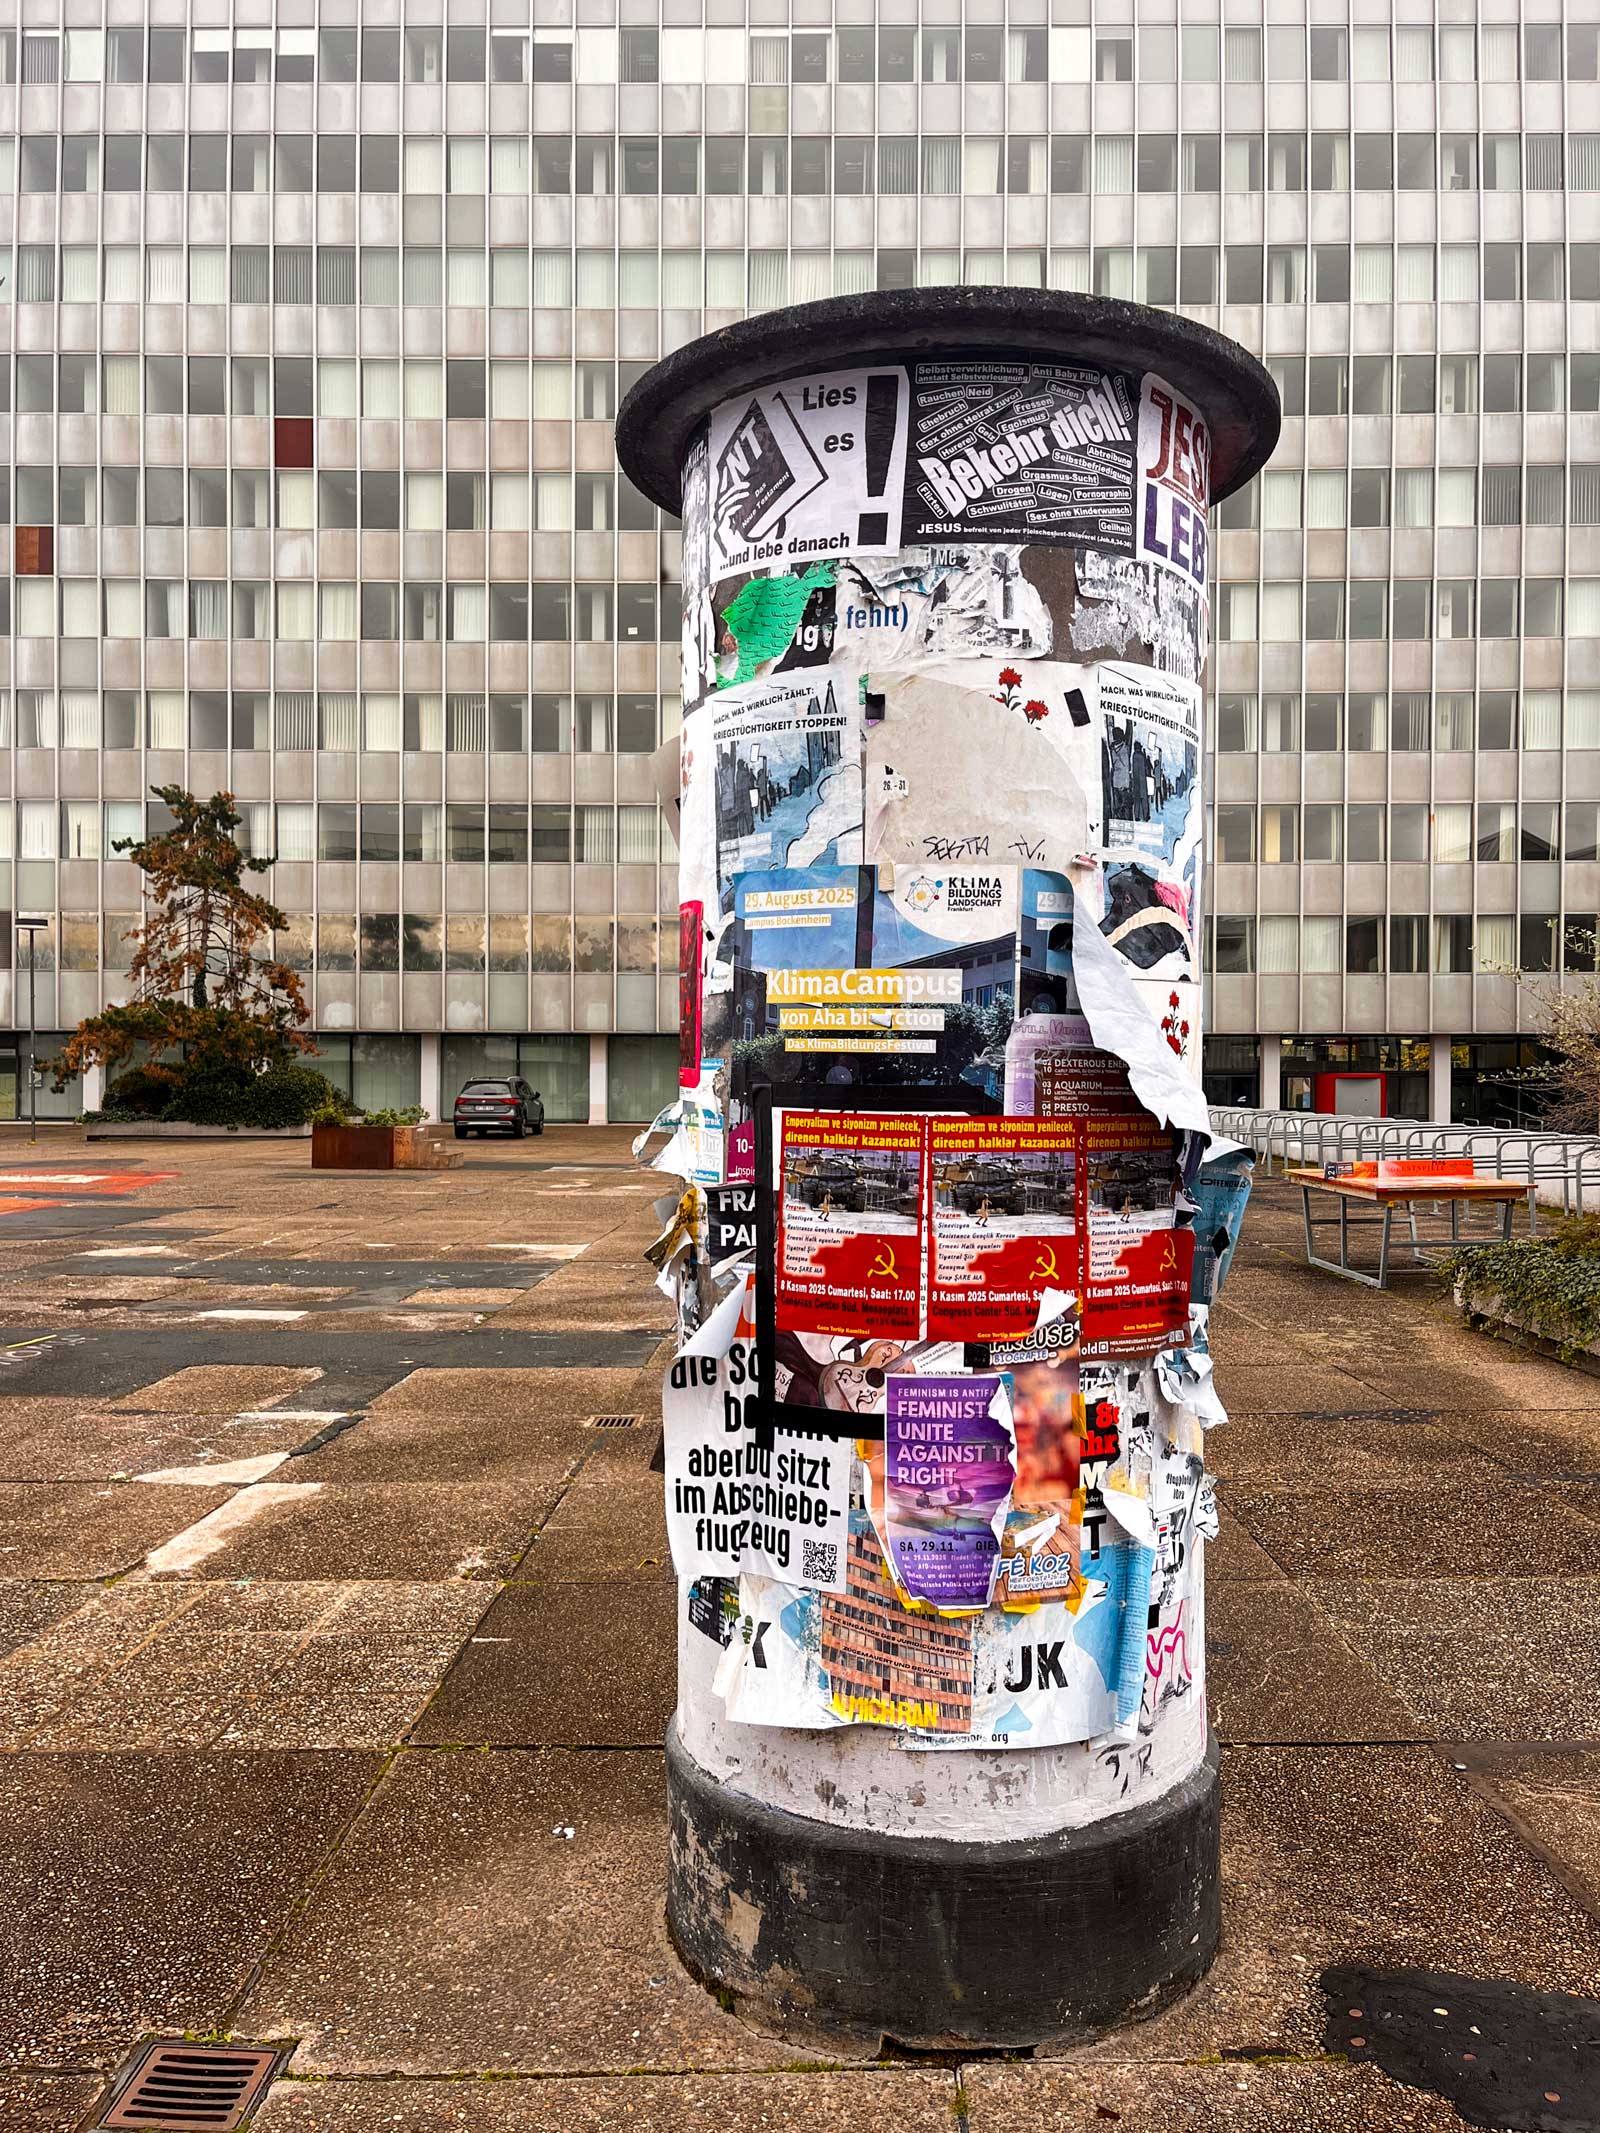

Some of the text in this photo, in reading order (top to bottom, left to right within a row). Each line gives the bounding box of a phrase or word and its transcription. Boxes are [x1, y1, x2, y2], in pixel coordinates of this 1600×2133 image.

[919, 366, 1024, 376] Selbstverwirklichung
[951, 374, 1028, 383] Selbstverleugnung
[1033, 367, 1098, 382] Anti Baby Pille
[802, 385, 857, 411] Lies
[920, 388, 991, 404] Rauchen Neid
[1050, 384, 1079, 399] Saufen
[1116, 379, 1130, 418] Stehlen
[1015, 397, 1052, 411] Fressen
[920, 402, 966, 430] Ehebruch
[920, 391, 1019, 450] Sex ohne Heirat zuvor
[1001, 413, 1046, 432] Egoismus
[977, 426, 996, 441] Geiz
[824, 432, 854, 453] es
[918, 374, 1132, 517] Bekehr dich!
[941, 435, 974, 457] Hurerei
[1089, 447, 1131, 465] Abtreibung
[1054, 451, 1131, 482] Selbstbefriedigung
[1023, 471, 1097, 483] Orgasmus-Sucht
[996, 486, 1031, 497] Drogen
[1040, 487, 1068, 500] Lügen
[1076, 490, 1129, 499] Pornographie
[742, 472, 790, 529] Neue Testament
[920, 486, 944, 515] Flirten
[970, 499, 1034, 515] Schwulitäten
[1030, 506, 1129, 521] Sex ohne Kinderwunsch
[917, 523, 961, 533] JESUS
[1101, 521, 1130, 533] Geilheit
[753, 541, 783, 560] lebe
[788, 532, 850, 554] danach
[847, 601, 908, 632] fehlt)
[1101, 685, 1174, 701] MACH, WAS WIRKLICH
[731, 707, 745, 718] WAS
[747, 694, 783, 711] WIRKLICH
[784, 687, 814, 700] ZÄHLT:
[1100, 700, 1178, 731] KRIEGSTÜCHTIGKEIT
[714, 717, 847, 740] KRIEGSTÜCHTIGKEIT STOPPEN!
[949, 877, 1001, 889] KLIMA
[745, 889, 855, 909] 29. August 2025
[948, 889, 1001, 898] BILDUNGS
[948, 898, 1001, 908] LANDSCHAFT
[776, 916, 831, 926] Bockenheim
[767, 969, 962, 1002] KlimaCampus
[781, 1009, 845, 1025] von Aha
[787, 1038, 934, 1053] Das KlimaBildungsFestival
[1055, 1059, 1105, 1068] DEXTEROUS
[1054, 1081, 1102, 1092] AQUARIUM
[1054, 1103, 1089, 1112] PRESTO
[785, 1116, 921, 1132] Emperyalizm ve siyonizm yenilecek,
[932, 1121, 1076, 1133] Emperyalizm ve siyonizm yenilecek,
[785, 1131, 920, 1148] direnen halklar kazanacak!
[933, 1136, 1076, 1149] direnen halklar kazanacak!
[1087, 1136, 1121, 1148] direnen
[780, 1280, 916, 1301] 8 Kasım 2025 Cumartesi, Saat: 17.00
[932, 1290, 1031, 1304] 8 Kasım 2025 Cumartesi,
[1092, 1288, 1112, 1298] Kasım
[1114, 1285, 1130, 1296] 2025
[994, 1350, 1048, 1364] BIOGRAFIE
[671, 1355, 717, 1389] die
[898, 1389, 946, 1397] FEMINISM
[898, 1423, 953, 1440] UNITE
[897, 1445, 985, 1462] AGAINST
[689, 1444, 743, 1477] aber
[777, 1449, 831, 1490] sitzt
[898, 1467, 956, 1485] RIGHT
[675, 1478, 841, 1528] im Abschiebe-
[696, 1519, 790, 1567] flugzeug
[900, 1540, 959, 1552] SA, 29.11.
[1031, 1553, 1070, 1575] KOZ
[830, 1615, 965, 1657] DIE DES JURIDICUMS SIND
[843, 1645, 951, 1677] ZUGEMAUERT UND BEWACHT
